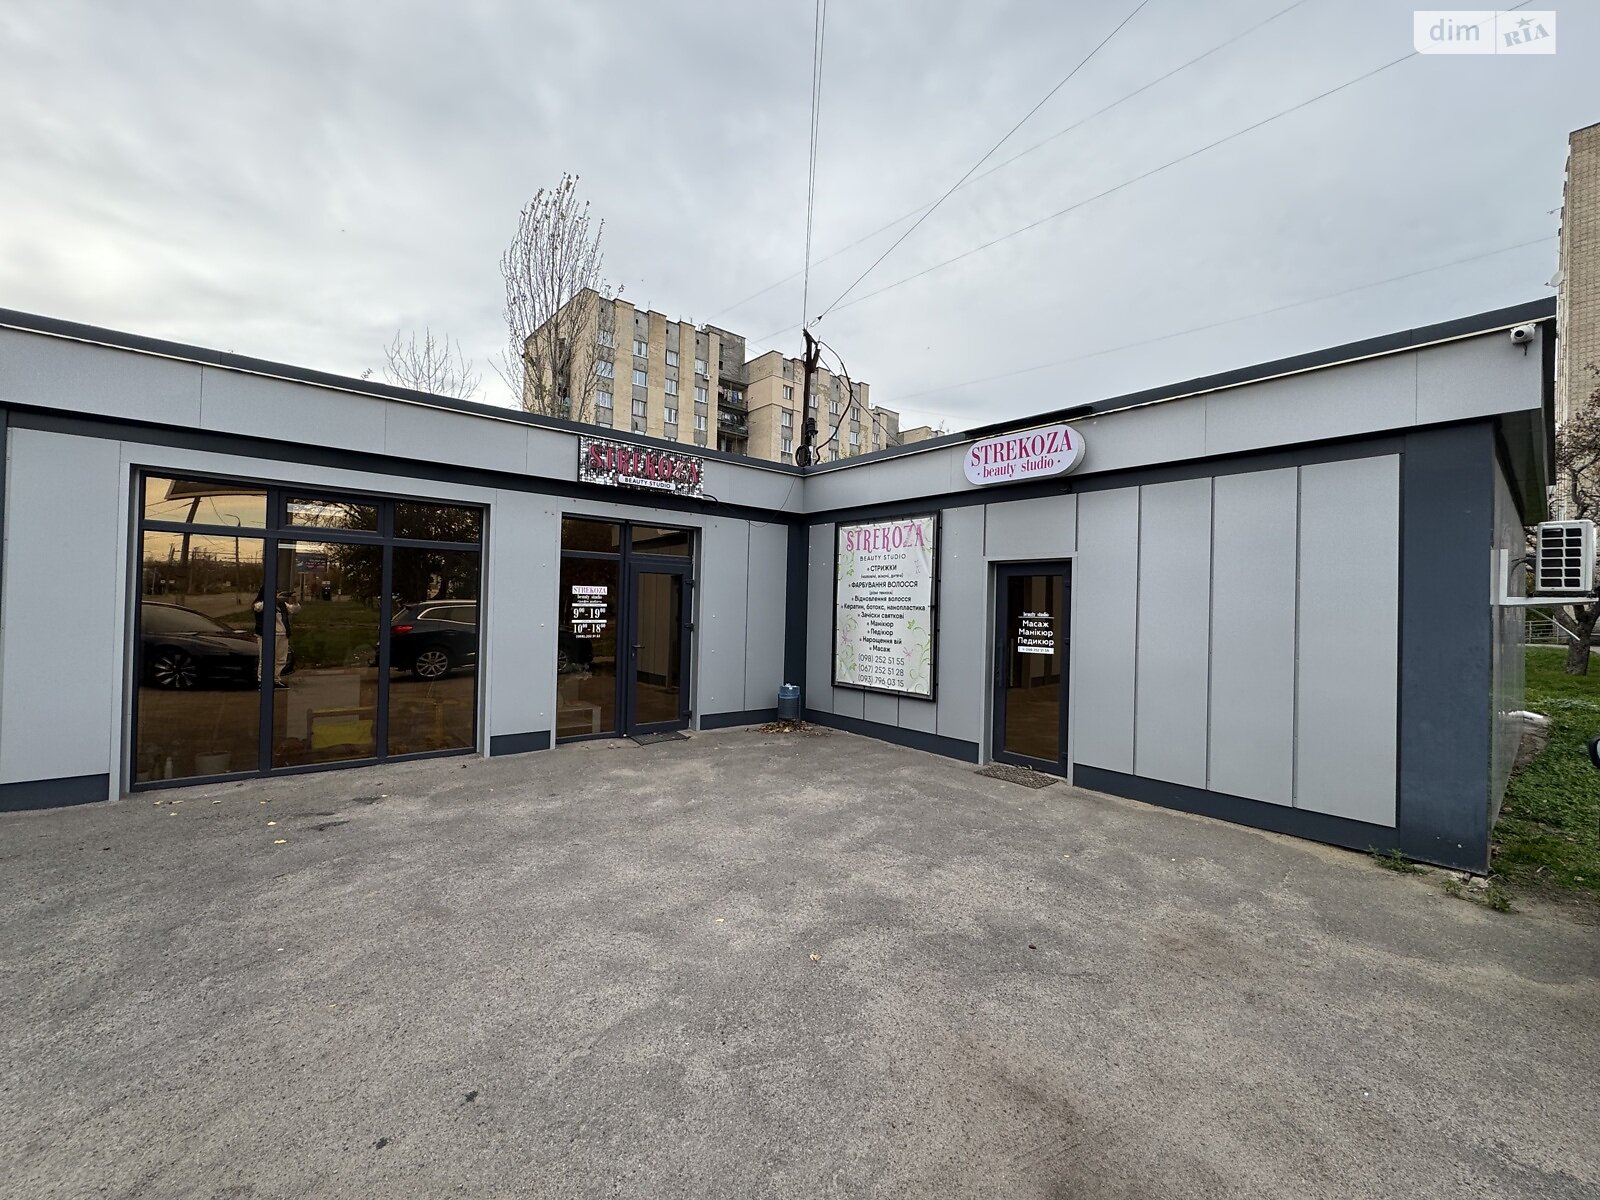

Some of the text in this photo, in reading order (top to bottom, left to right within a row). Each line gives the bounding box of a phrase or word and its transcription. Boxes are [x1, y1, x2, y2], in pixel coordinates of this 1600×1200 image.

[971, 429, 1072, 467] STREKOZA
[983, 456, 1054, 478] beauty studio
[624, 477, 671, 489] BEAUTY STUDIO
[847, 523, 925, 553] STREKOZA
[888, 580, 918, 588] ВОЛОССЯ
[870, 620, 894, 628] Манікюр
[1022, 620, 1049, 628] Масаж
[1018, 628, 1054, 638] Манікюр
[862, 636, 893, 644] Нарощення
[1017, 636, 1055, 647] Педикюр
[858, 652, 904, 666] (098) 252 51 55
[858, 663, 904, 677] (067) 252 51 28
[858, 673, 904, 687] (093) 796 03 15
